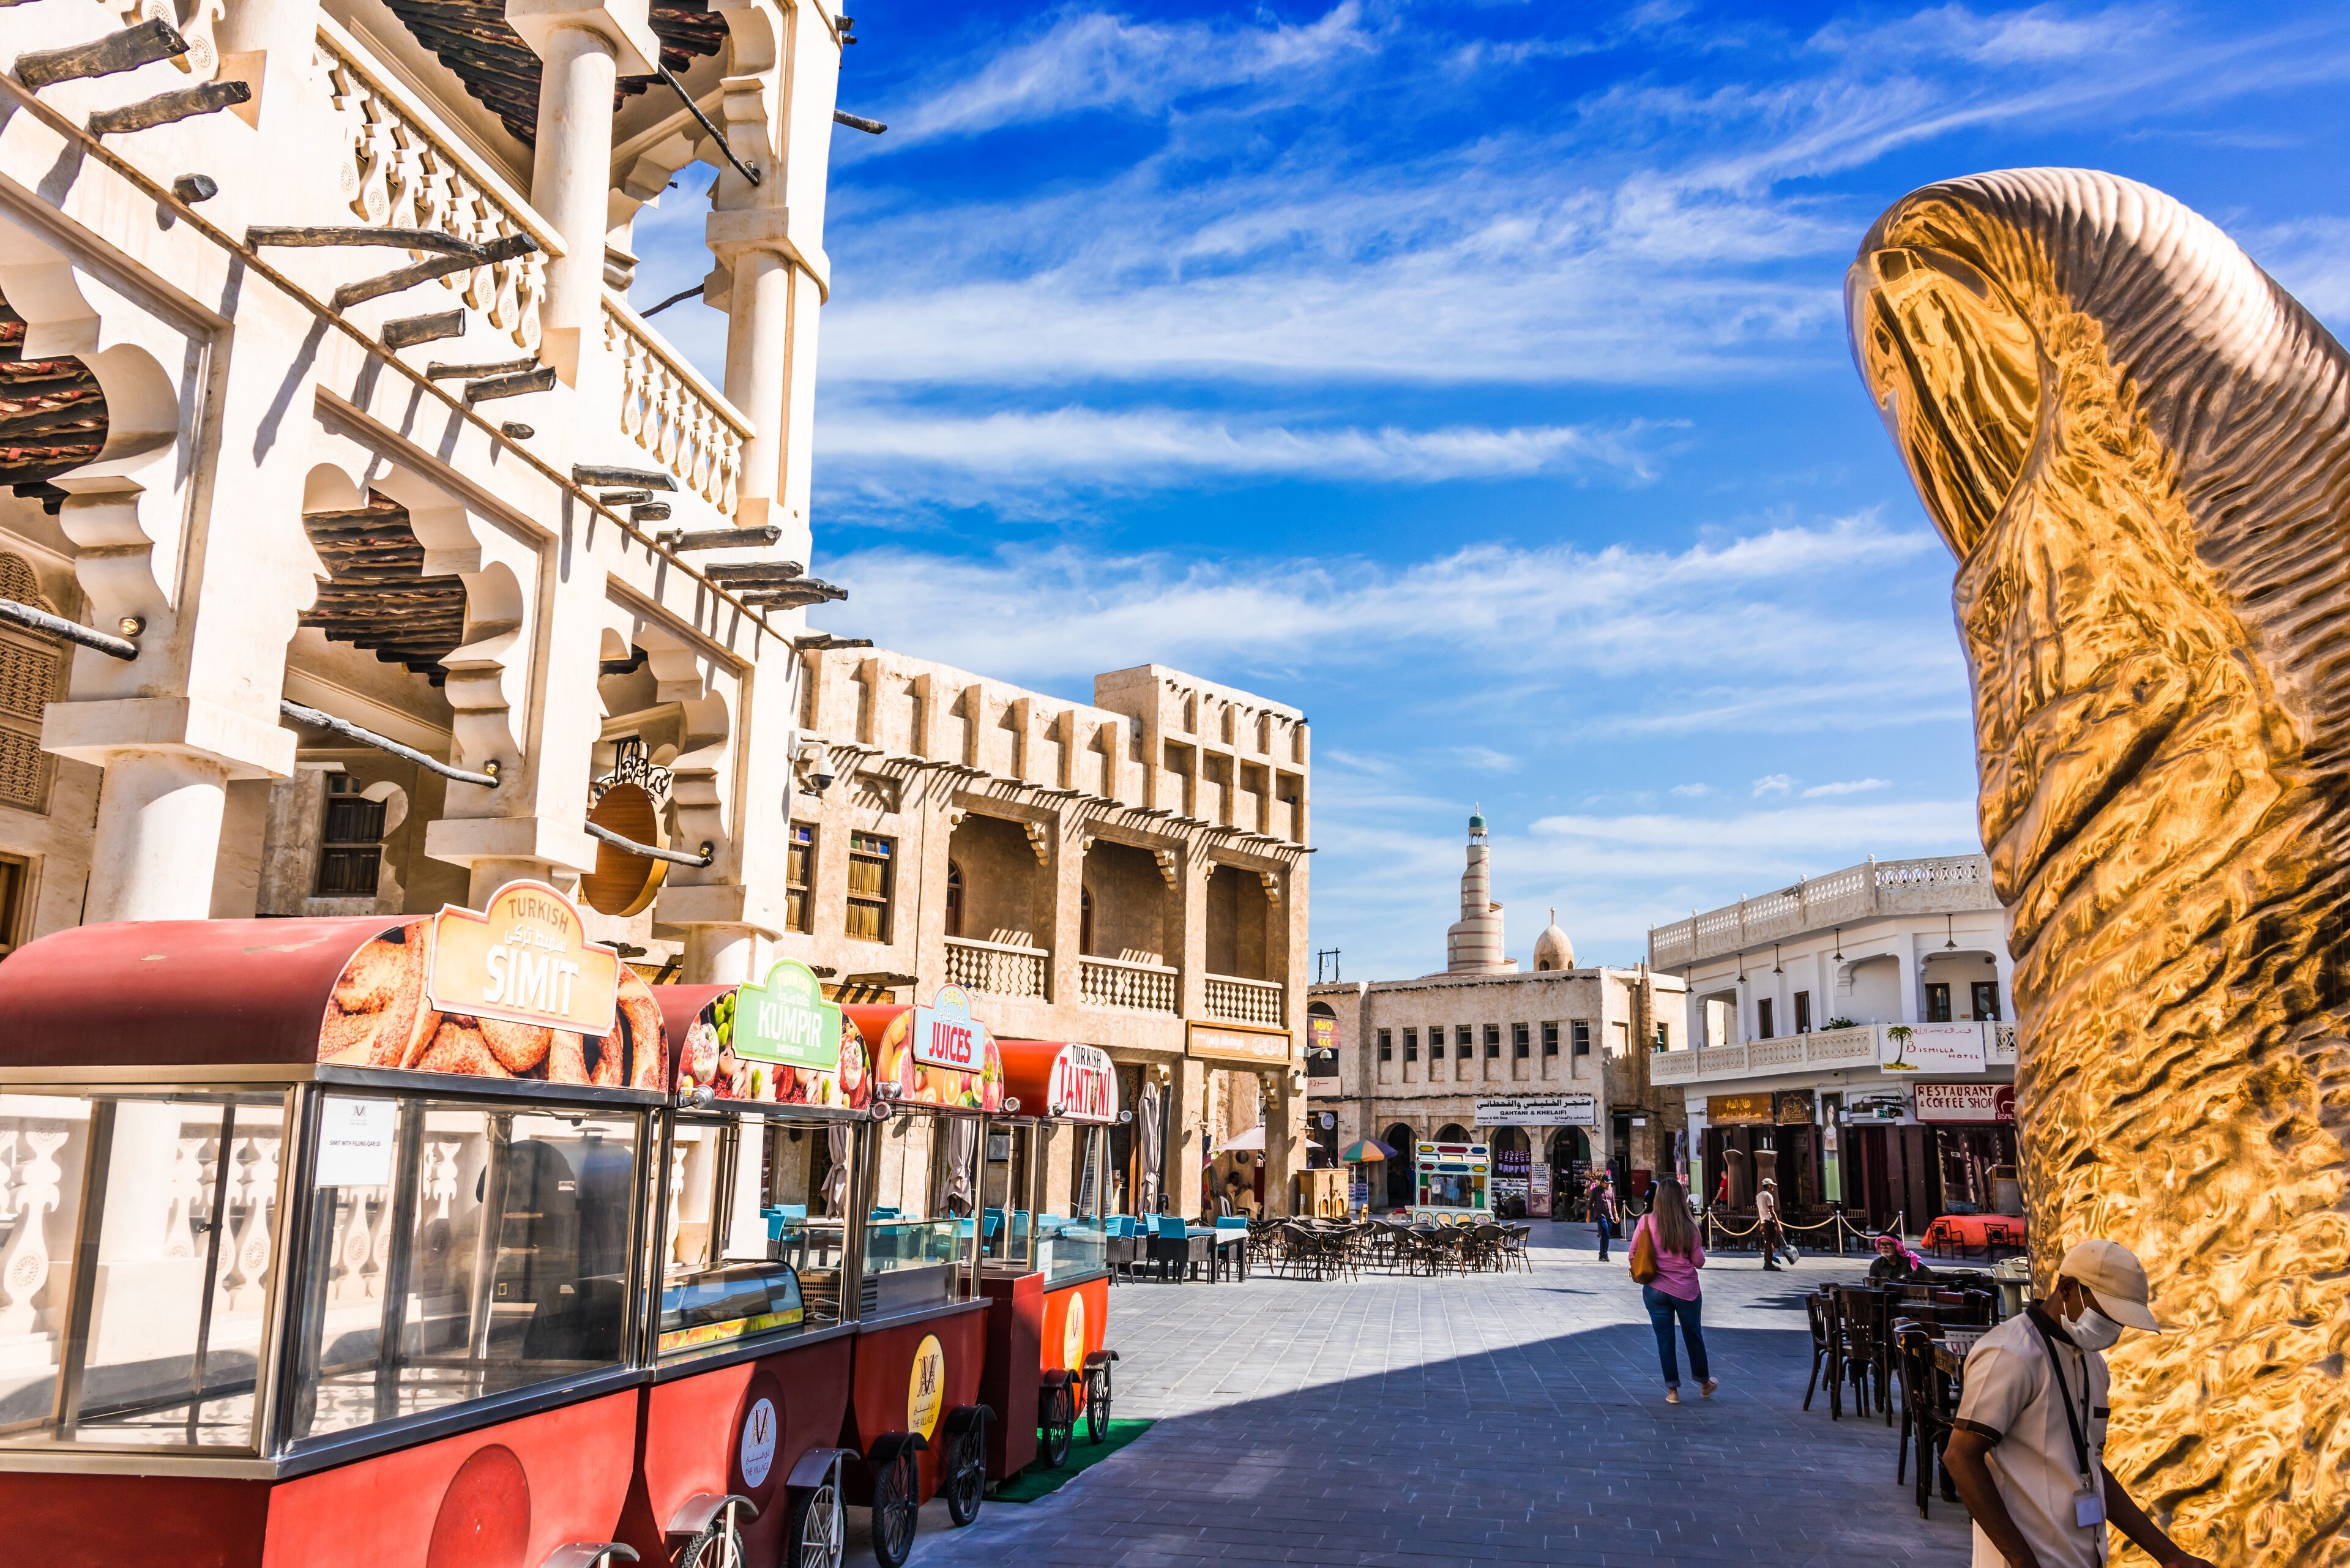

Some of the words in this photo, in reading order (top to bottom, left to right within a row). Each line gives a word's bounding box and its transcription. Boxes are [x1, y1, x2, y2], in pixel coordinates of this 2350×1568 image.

[508, 897, 569, 934] TURKISH
[483, 944, 579, 1017] SIMIT
[776, 971, 812, 996] TURKISH
[943, 989, 964, 1012] FRESH
[757, 1001, 822, 1048] KUMPIR
[929, 1021, 972, 1063] JUICES
[1072, 1045, 1102, 1069] TURKISH
[1563, 1099, 1592, 1108] متجر
[1918, 1086, 1993, 1097] RESTAURANT
[1927, 1098, 1964, 1108] COFFEE
[1968, 1098, 1993, 1108] SHOP
[753, 1462, 769, 1474] VILLAGE
